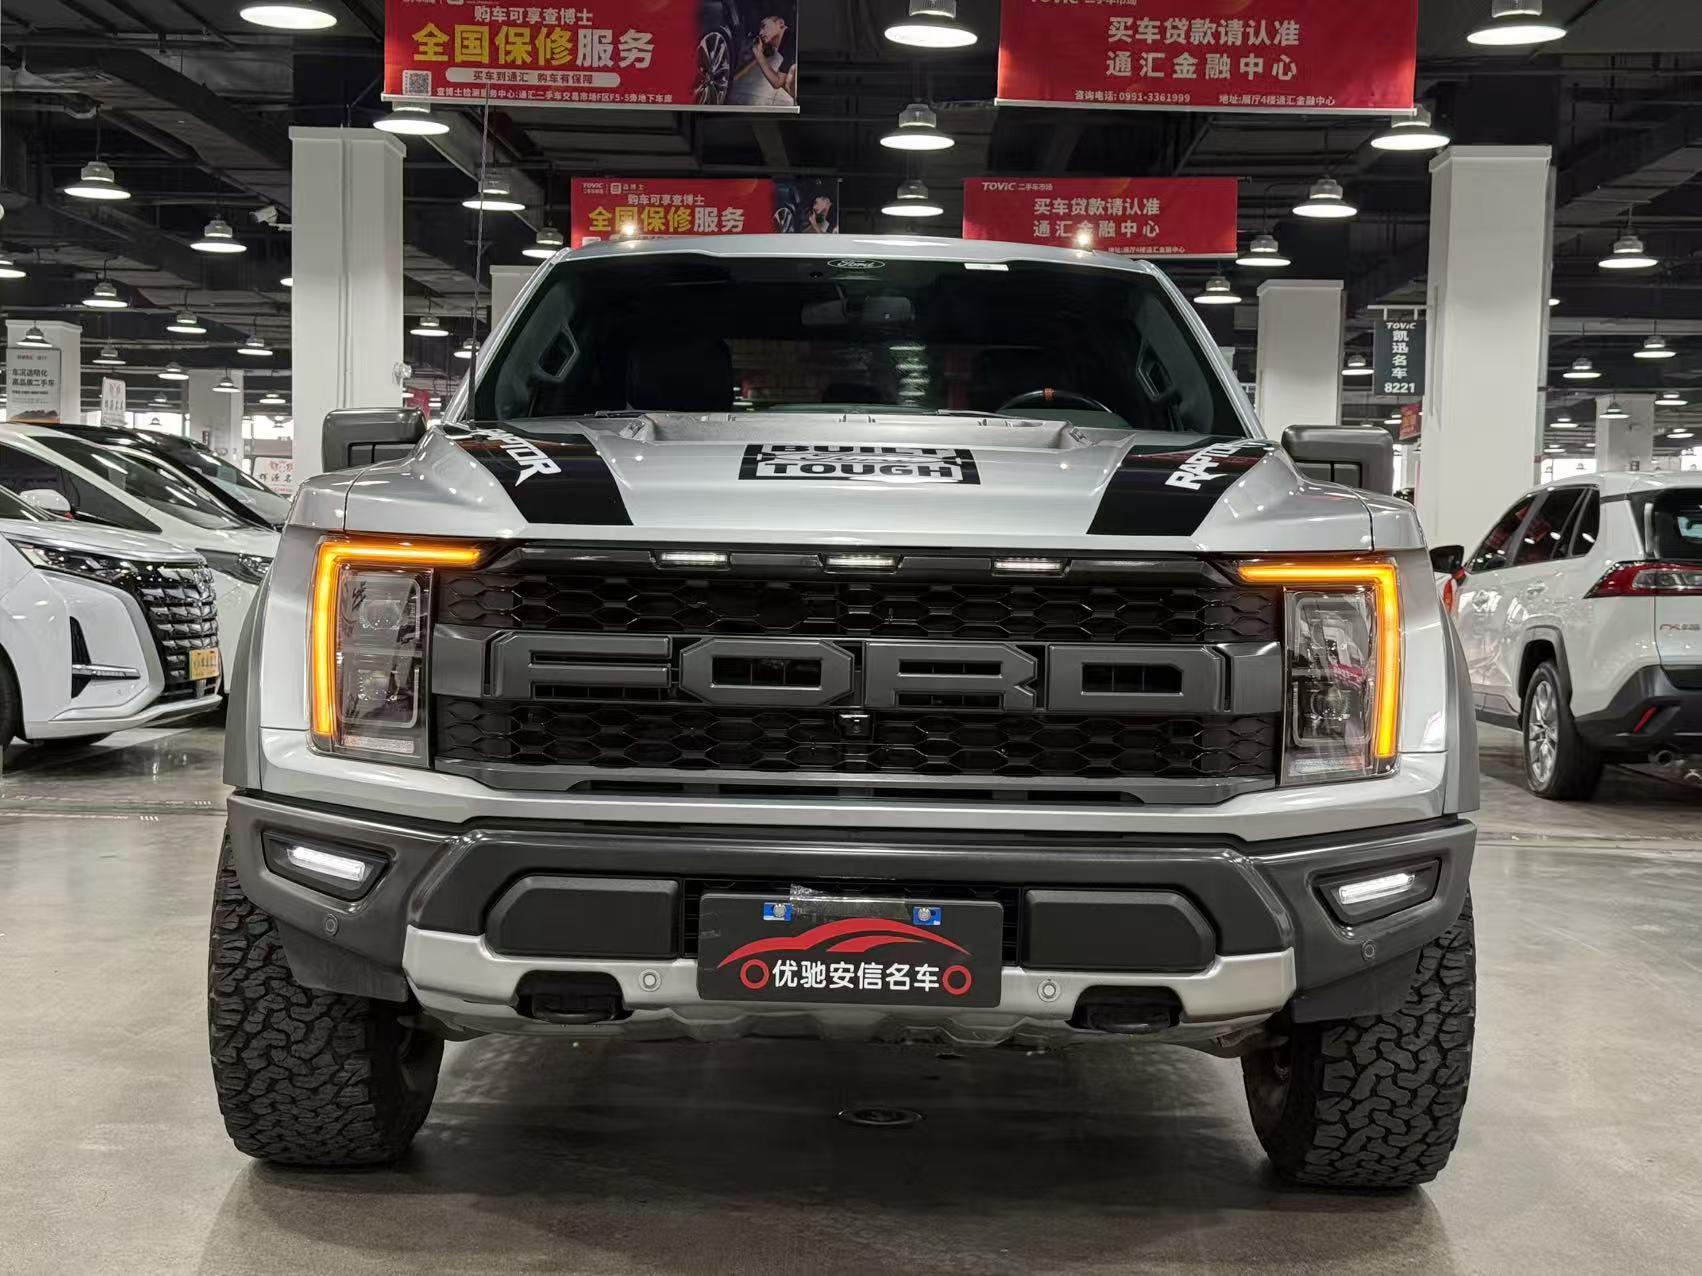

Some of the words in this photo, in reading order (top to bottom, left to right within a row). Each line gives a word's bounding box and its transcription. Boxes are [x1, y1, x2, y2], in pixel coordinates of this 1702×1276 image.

[474, 5, 592, 26] 购车可享查博士
[1107, 16, 1300, 46] 买车贷款请认准
[411, 23, 655, 69] 全国保修服务
[1105, 51, 1298, 80] 通汇金融中心
[588, 206, 745, 232] 全国保修服务
[1034, 197, 1160, 215] 买车贷款请认准
[1391, 330, 1409, 379] 凯迅名车
[1384, 382, 1416, 393] 8221
[764, 463, 953, 478] TOUGH
[488, 634, 1228, 714] FORD
[772, 959, 940, 992] 优驰安信名车
